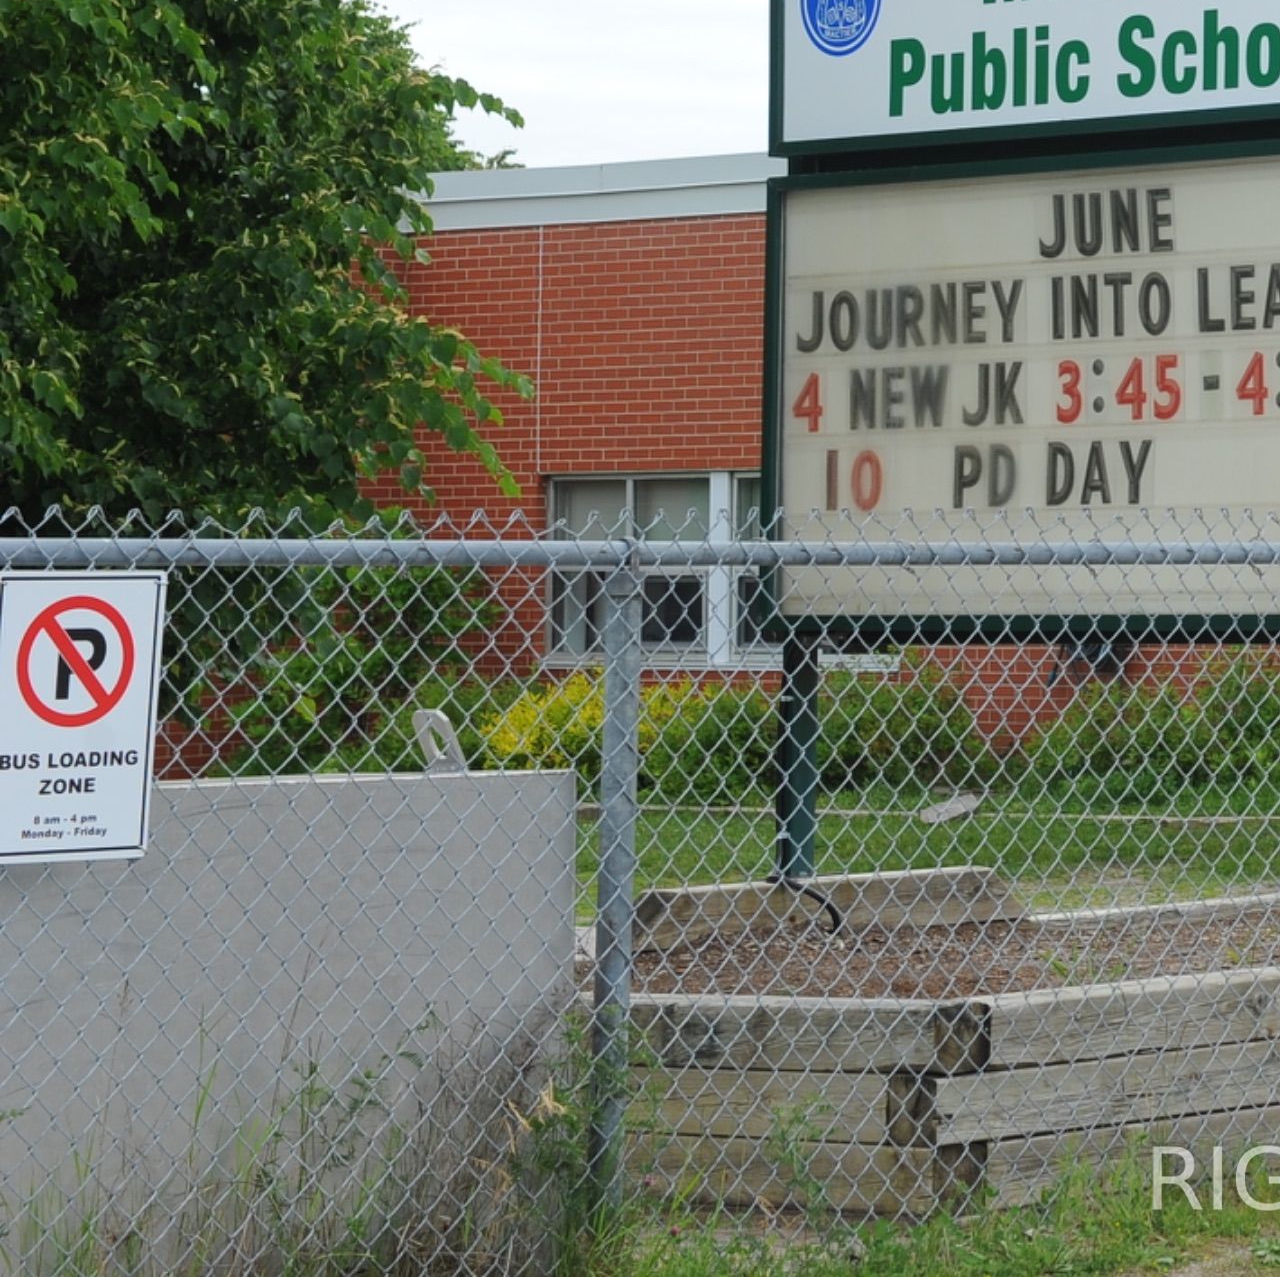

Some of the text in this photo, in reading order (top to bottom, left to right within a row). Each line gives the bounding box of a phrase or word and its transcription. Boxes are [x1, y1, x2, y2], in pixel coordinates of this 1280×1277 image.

[888, 25, 1091, 117] Public
[1038, 188, 1174, 258] JUNE
[796, 278, 1024, 353] JOURNEY
[1051, 270, 1171, 340] INTO
[792, 372, 823, 433] 4
[849, 364, 949, 430] NEW
[962, 360, 1024, 426] JK
[826, 439, 1152, 512] 10 PD DAY
[55, 627, 107, 700] P
[0, 750, 138, 770] BUS LOADING
[39, 777, 96, 795] ZONE
[21, 828, 63, 839] Monday
[74, 827, 107, 837] Friday
[43, 816, 60, 825] am
[70, 814, 77, 823] 4
[80, 815, 97, 825] pm
